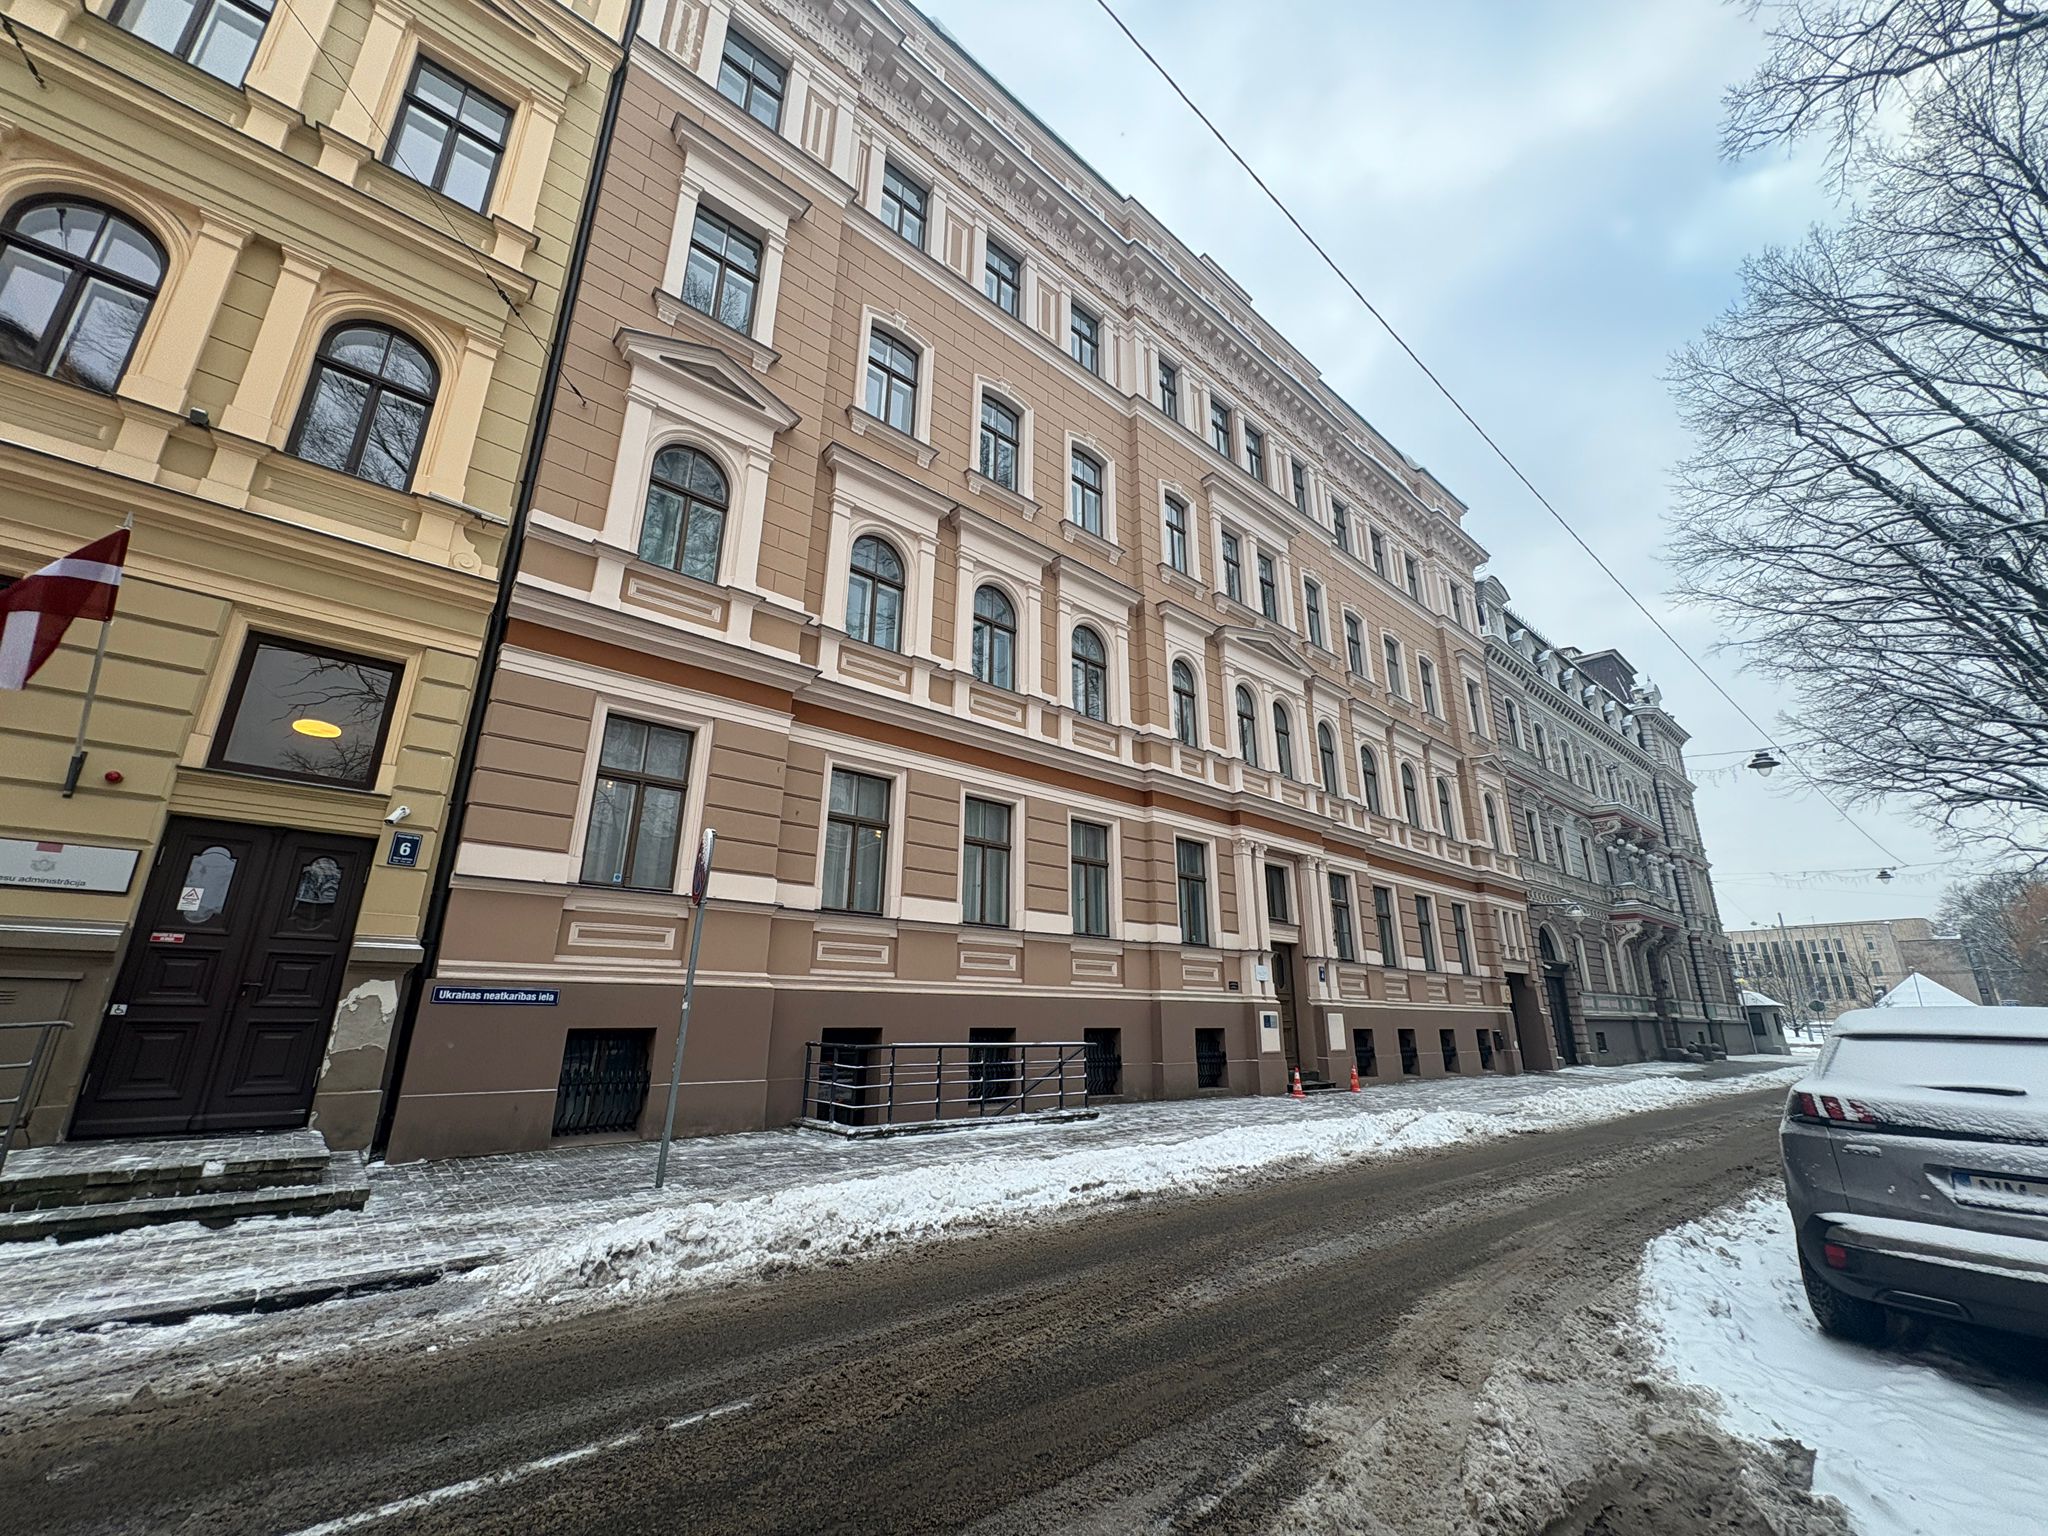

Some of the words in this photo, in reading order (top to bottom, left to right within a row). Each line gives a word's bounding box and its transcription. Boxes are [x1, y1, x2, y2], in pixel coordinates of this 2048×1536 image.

[400, 842, 411, 856] 6
[439, 990, 482, 1000] Ukrainas
[483, 991, 537, 1001] neatkarības
